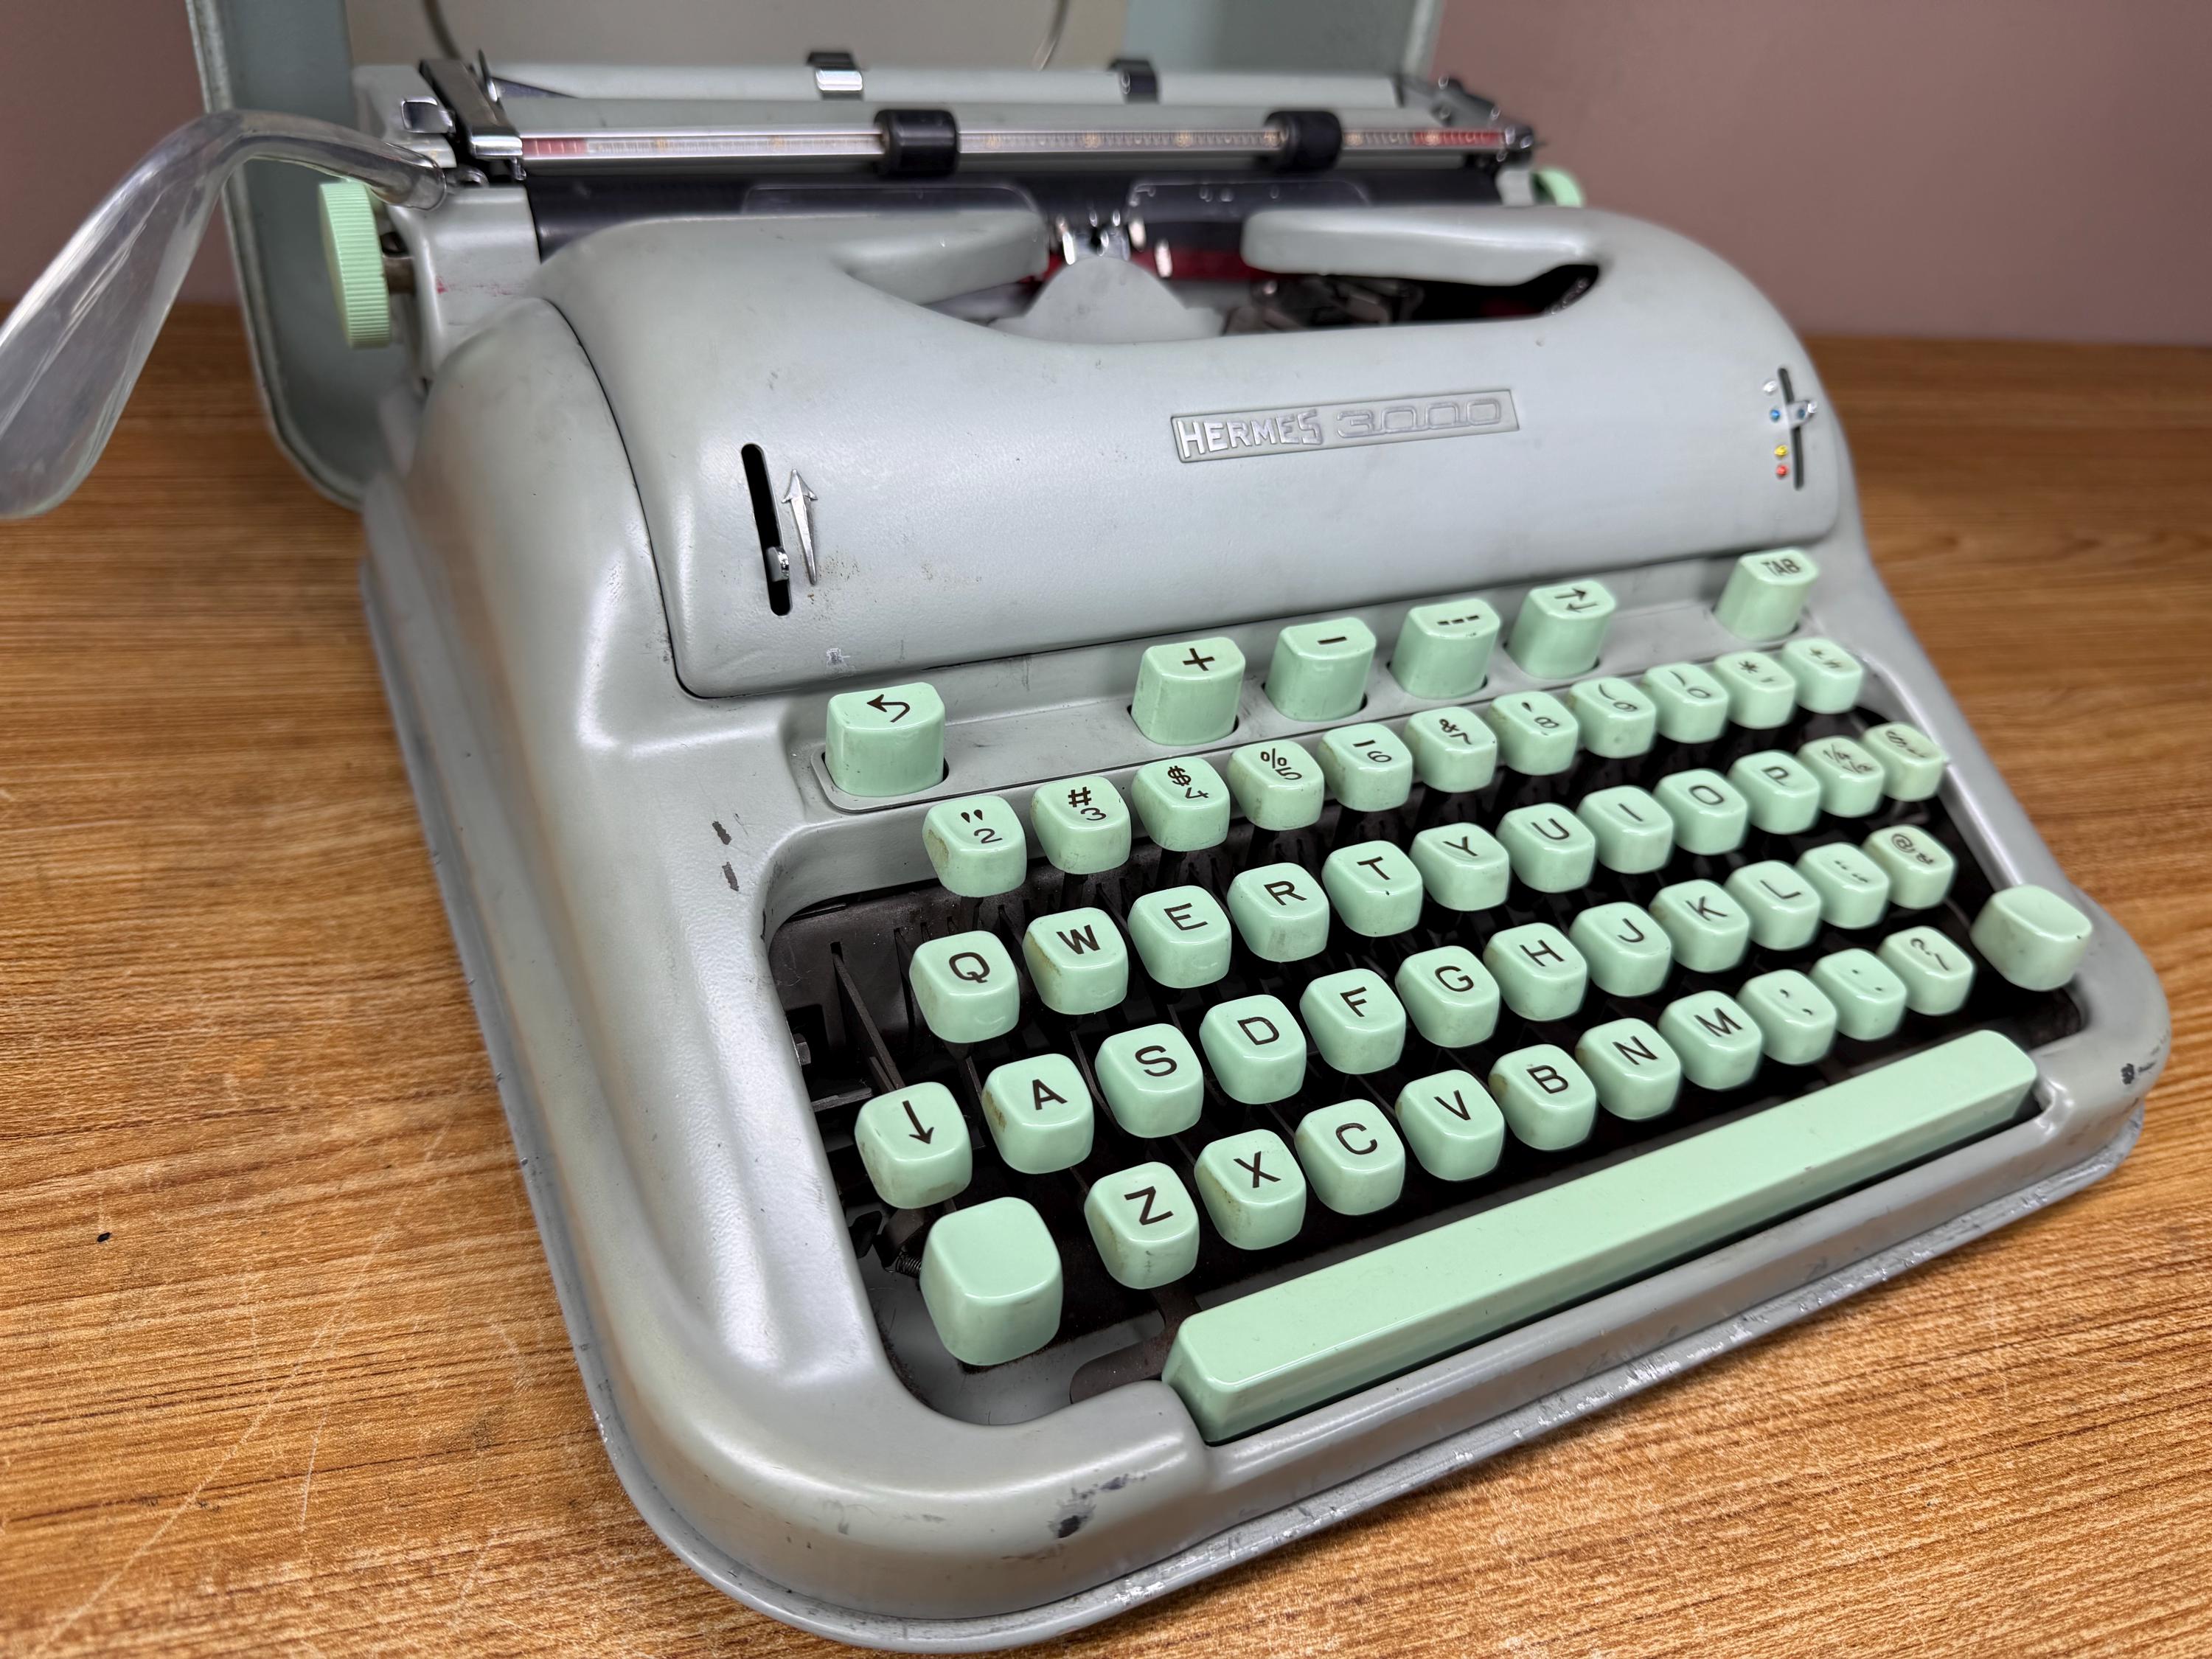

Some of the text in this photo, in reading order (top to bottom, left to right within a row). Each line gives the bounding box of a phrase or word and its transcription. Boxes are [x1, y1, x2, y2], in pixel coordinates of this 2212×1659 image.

[1178, 398, 1501, 459] HERMES 3000
[1761, 558, 1801, 576] TAB
[1598, 684, 1615, 700] (
[1534, 717, 1560, 729] 8
[1260, 748, 1287, 769] %
[1366, 751, 1392, 763] 6
[1167, 765, 1192, 787] $
[1276, 767, 1303, 781] 5
[1761, 766, 1790, 786] P
[1067, 786, 1093, 809] #
[1185, 787, 1209, 799] 4
[1688, 785, 1725, 806] O
[1080, 807, 1107, 821] 3
[973, 828, 1003, 844] 2
[1531, 818, 1571, 841] U
[1443, 835, 1478, 857] Y
[1891, 833, 1916, 854] @
[1356, 856, 1391, 880] T
[1263, 880, 1307, 906] R
[1760, 880, 1802, 900] L
[1163, 902, 1208, 931] E
[1685, 895, 1730, 922] K
[1056, 924, 1101, 955] W
[1618, 918, 1645, 943] J
[1519, 939, 1565, 967] H
[948, 951, 990, 984] Q
[1434, 965, 1475, 992] G
[1339, 986, 1367, 1018] F
[1237, 1016, 1280, 1046] D
[1694, 1006, 1743, 1037] M
[1135, 1045, 1178, 1077] S
[1611, 1035, 1659, 1066] N
[1526, 1065, 1569, 1094] B
[1032, 1079, 1068, 1111] A
[1433, 1090, 1471, 1121] V
[1335, 1122, 1378, 1155] C
[1233, 1150, 1281, 1189] X
[1124, 1186, 1174, 1226] Z
